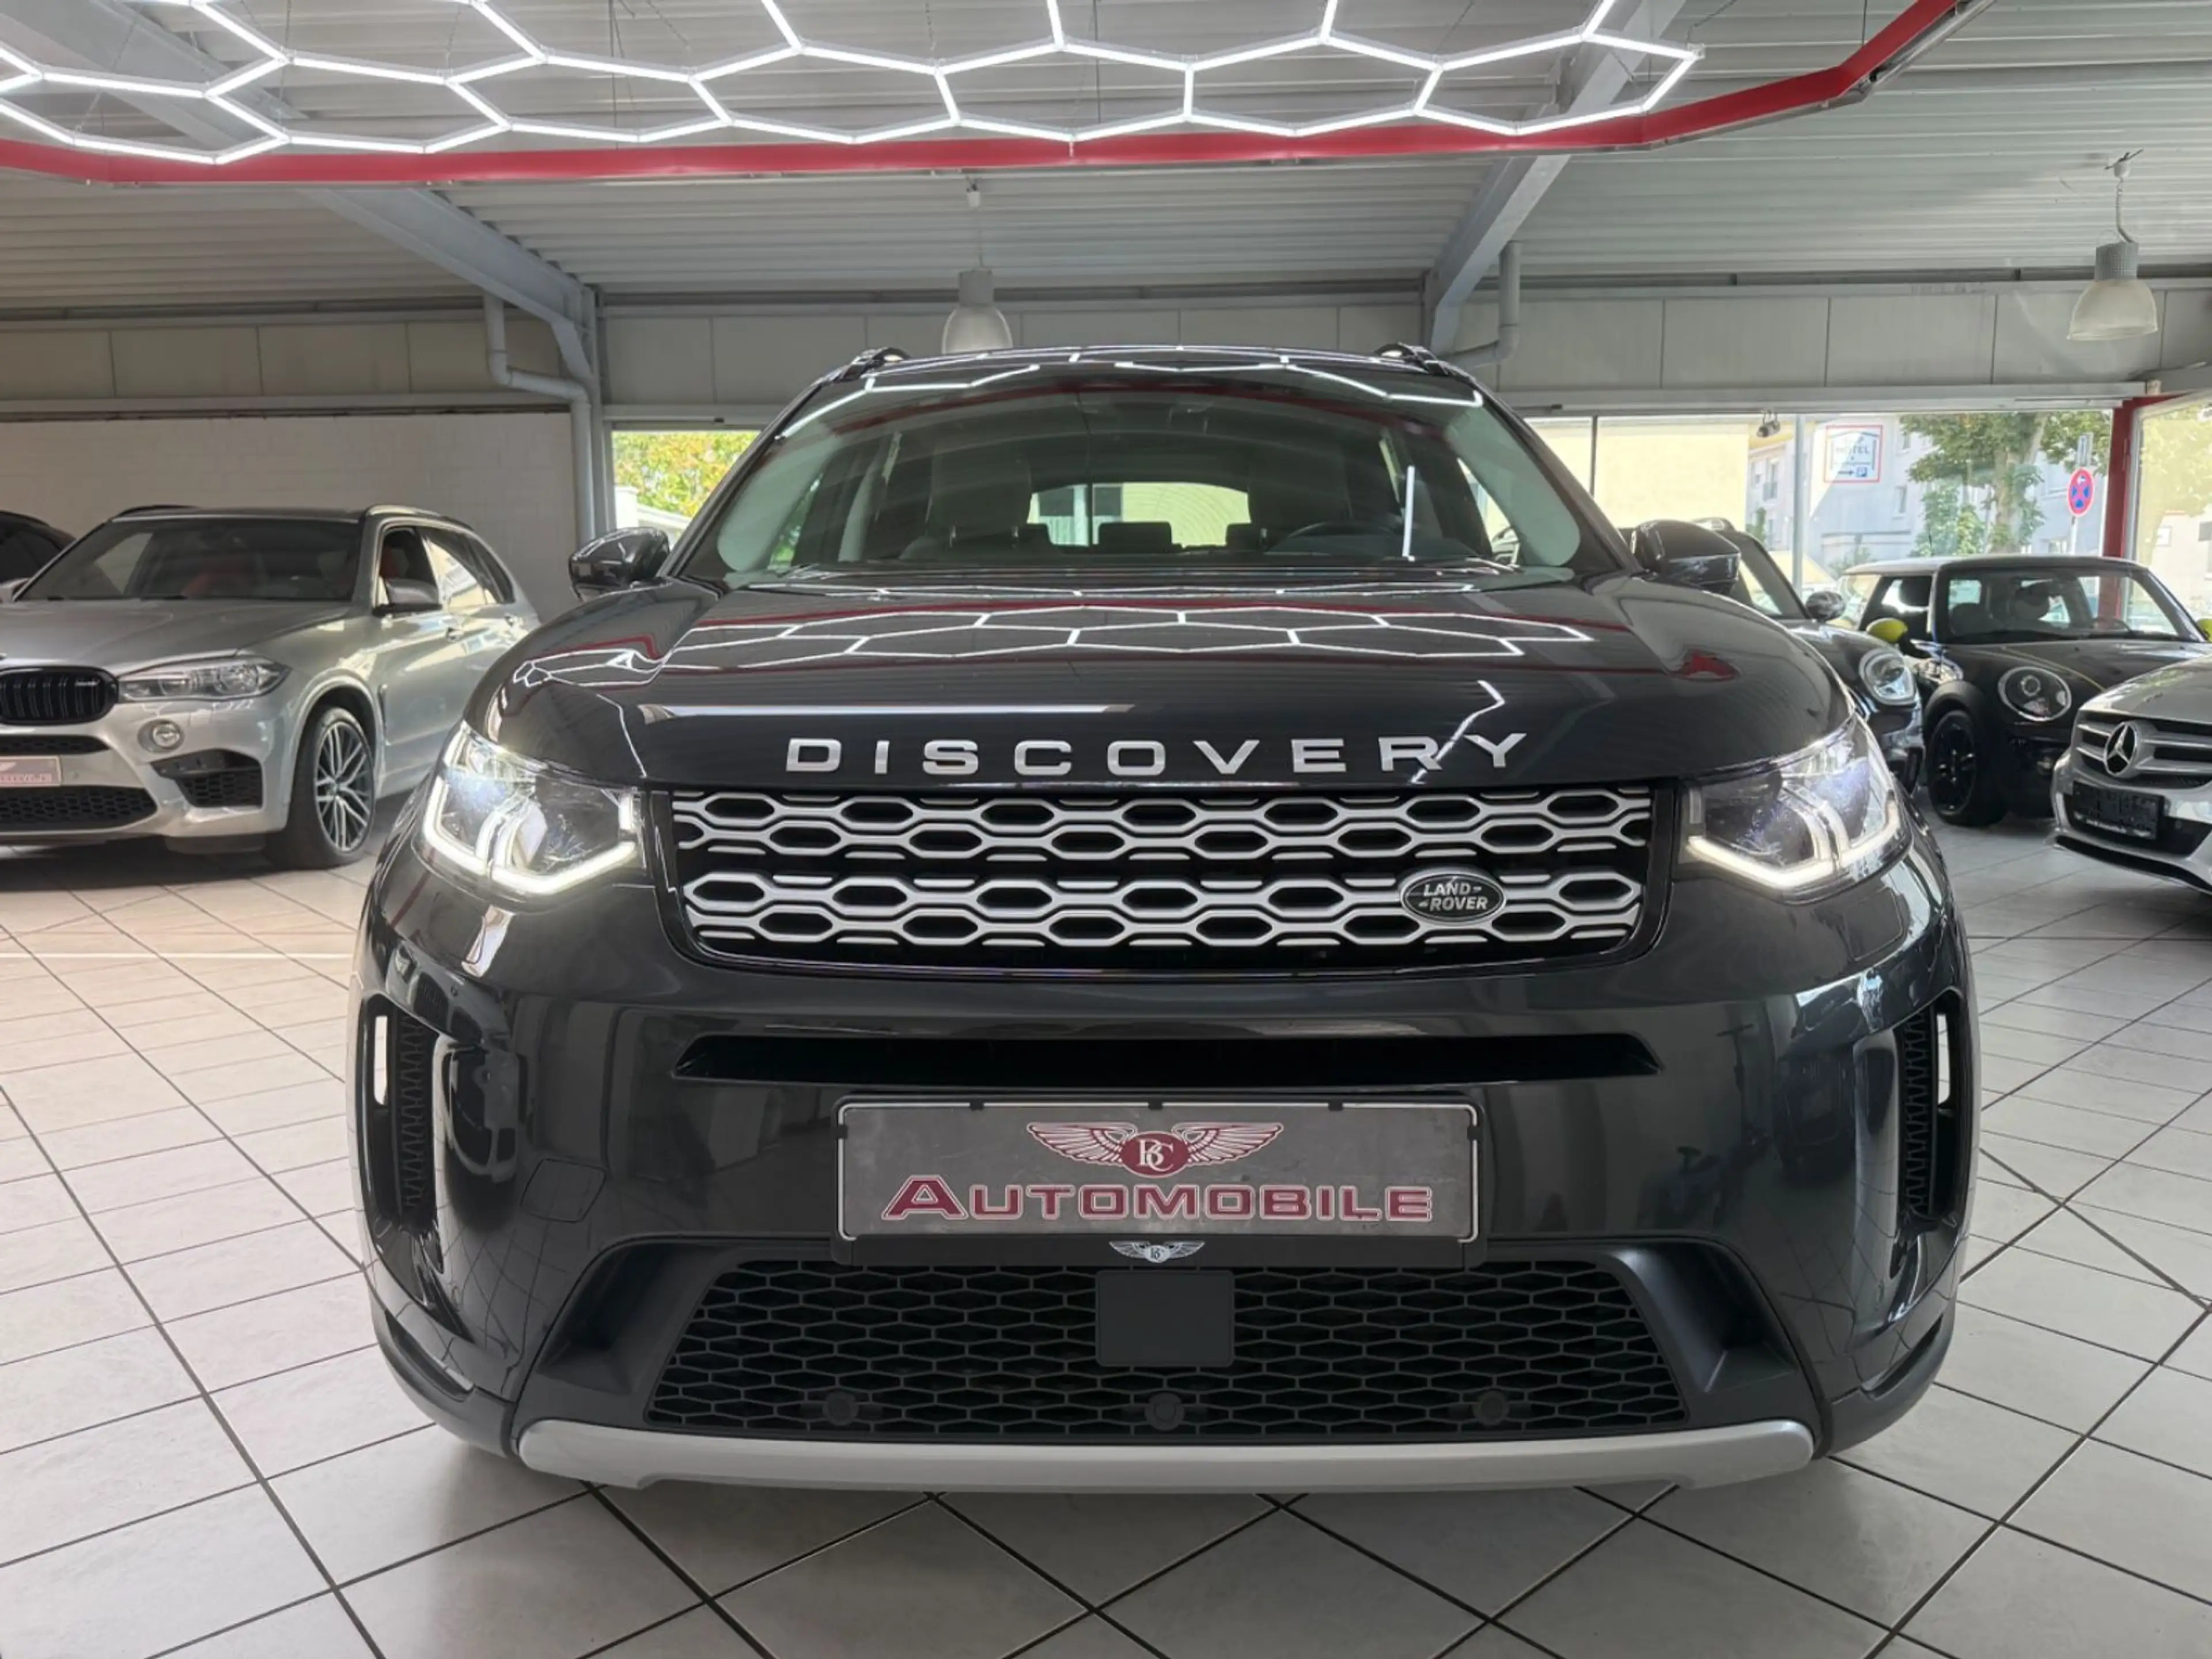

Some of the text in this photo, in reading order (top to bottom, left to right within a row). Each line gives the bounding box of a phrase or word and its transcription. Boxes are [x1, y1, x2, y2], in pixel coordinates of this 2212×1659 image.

[786, 733, 1527, 776] DISCOVERY
[1423, 882, 1470, 897] LAND
[1430, 896, 1488, 912] ROVER
[881, 1175, 1433, 1222] AUTOMOBILE
